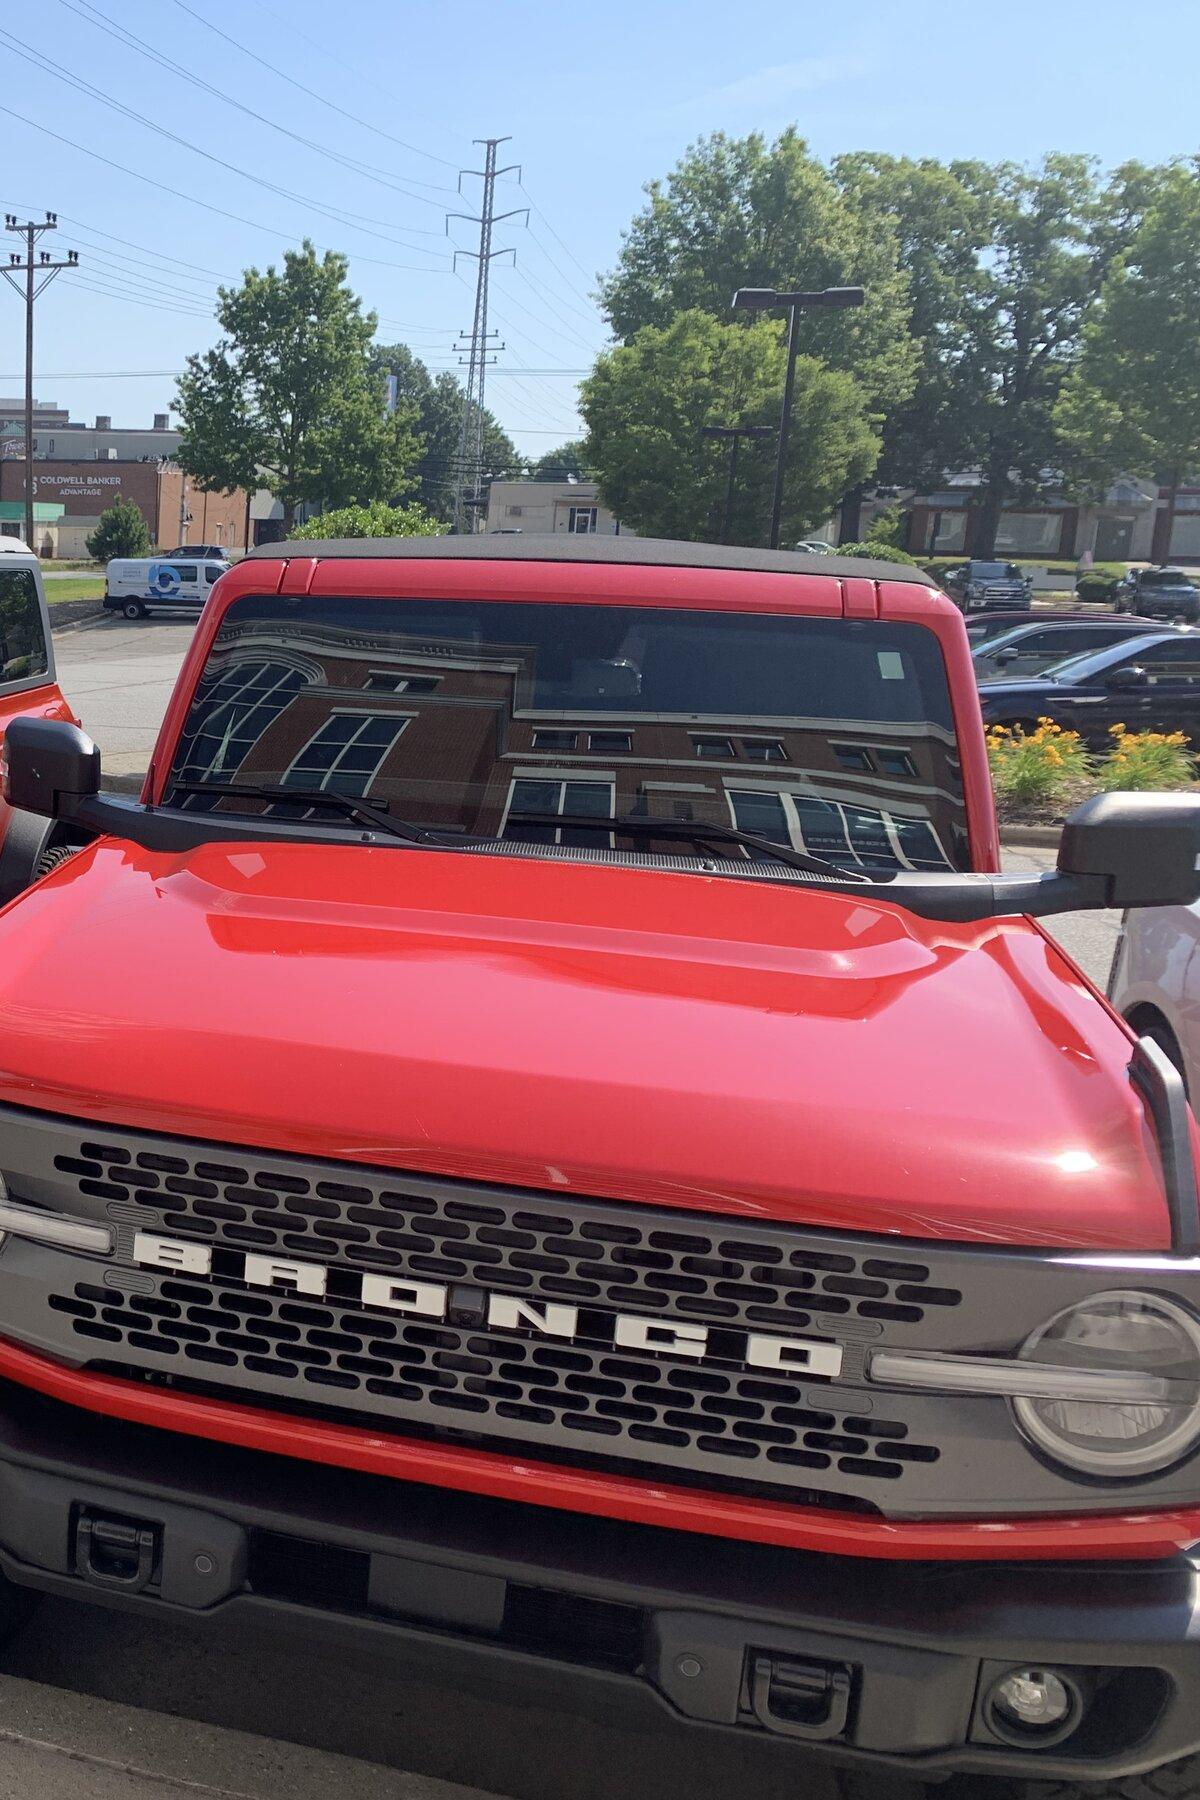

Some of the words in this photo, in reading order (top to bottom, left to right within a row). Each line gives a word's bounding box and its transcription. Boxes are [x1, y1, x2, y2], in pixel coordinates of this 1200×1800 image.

[40, 476, 85, 485] COLDWELL
[87, 477, 121, 485] BANKER
[60, 488, 101, 496] ADVANTAGE
[133, 1231, 843, 1378] BRONCO
